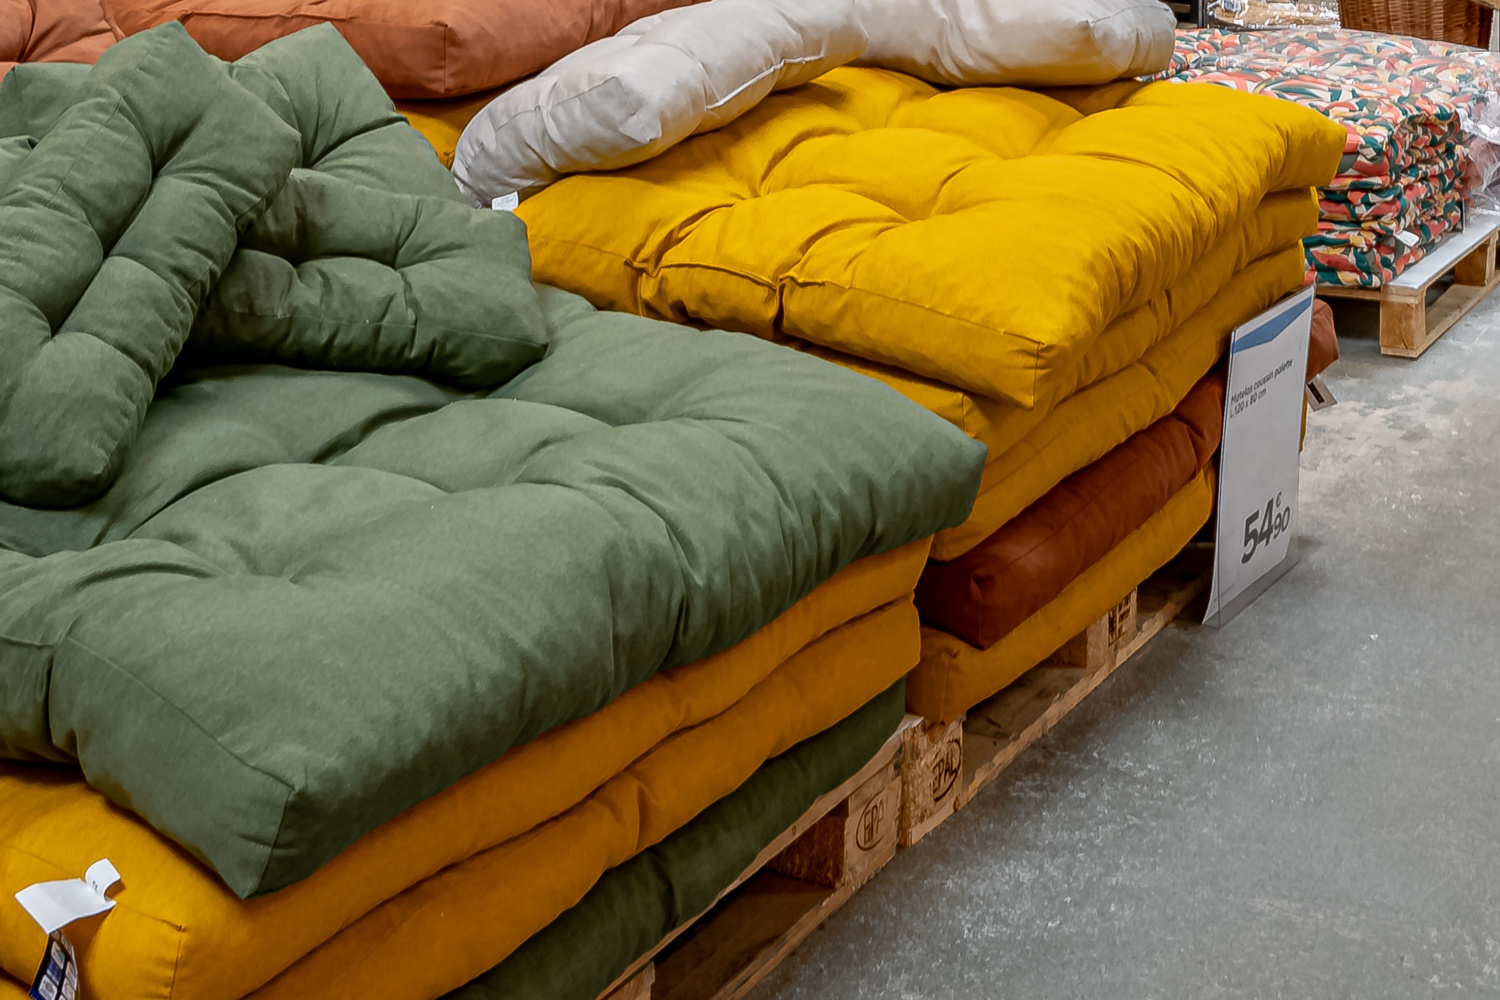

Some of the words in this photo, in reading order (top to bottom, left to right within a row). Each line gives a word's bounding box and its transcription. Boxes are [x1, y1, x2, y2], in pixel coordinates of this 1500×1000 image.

[1230, 385, 1253, 406] Matelas
[1253, 371, 1274, 390] coussin
[1274, 359, 1293, 379] palette
[1258, 387, 1267, 400] cm
